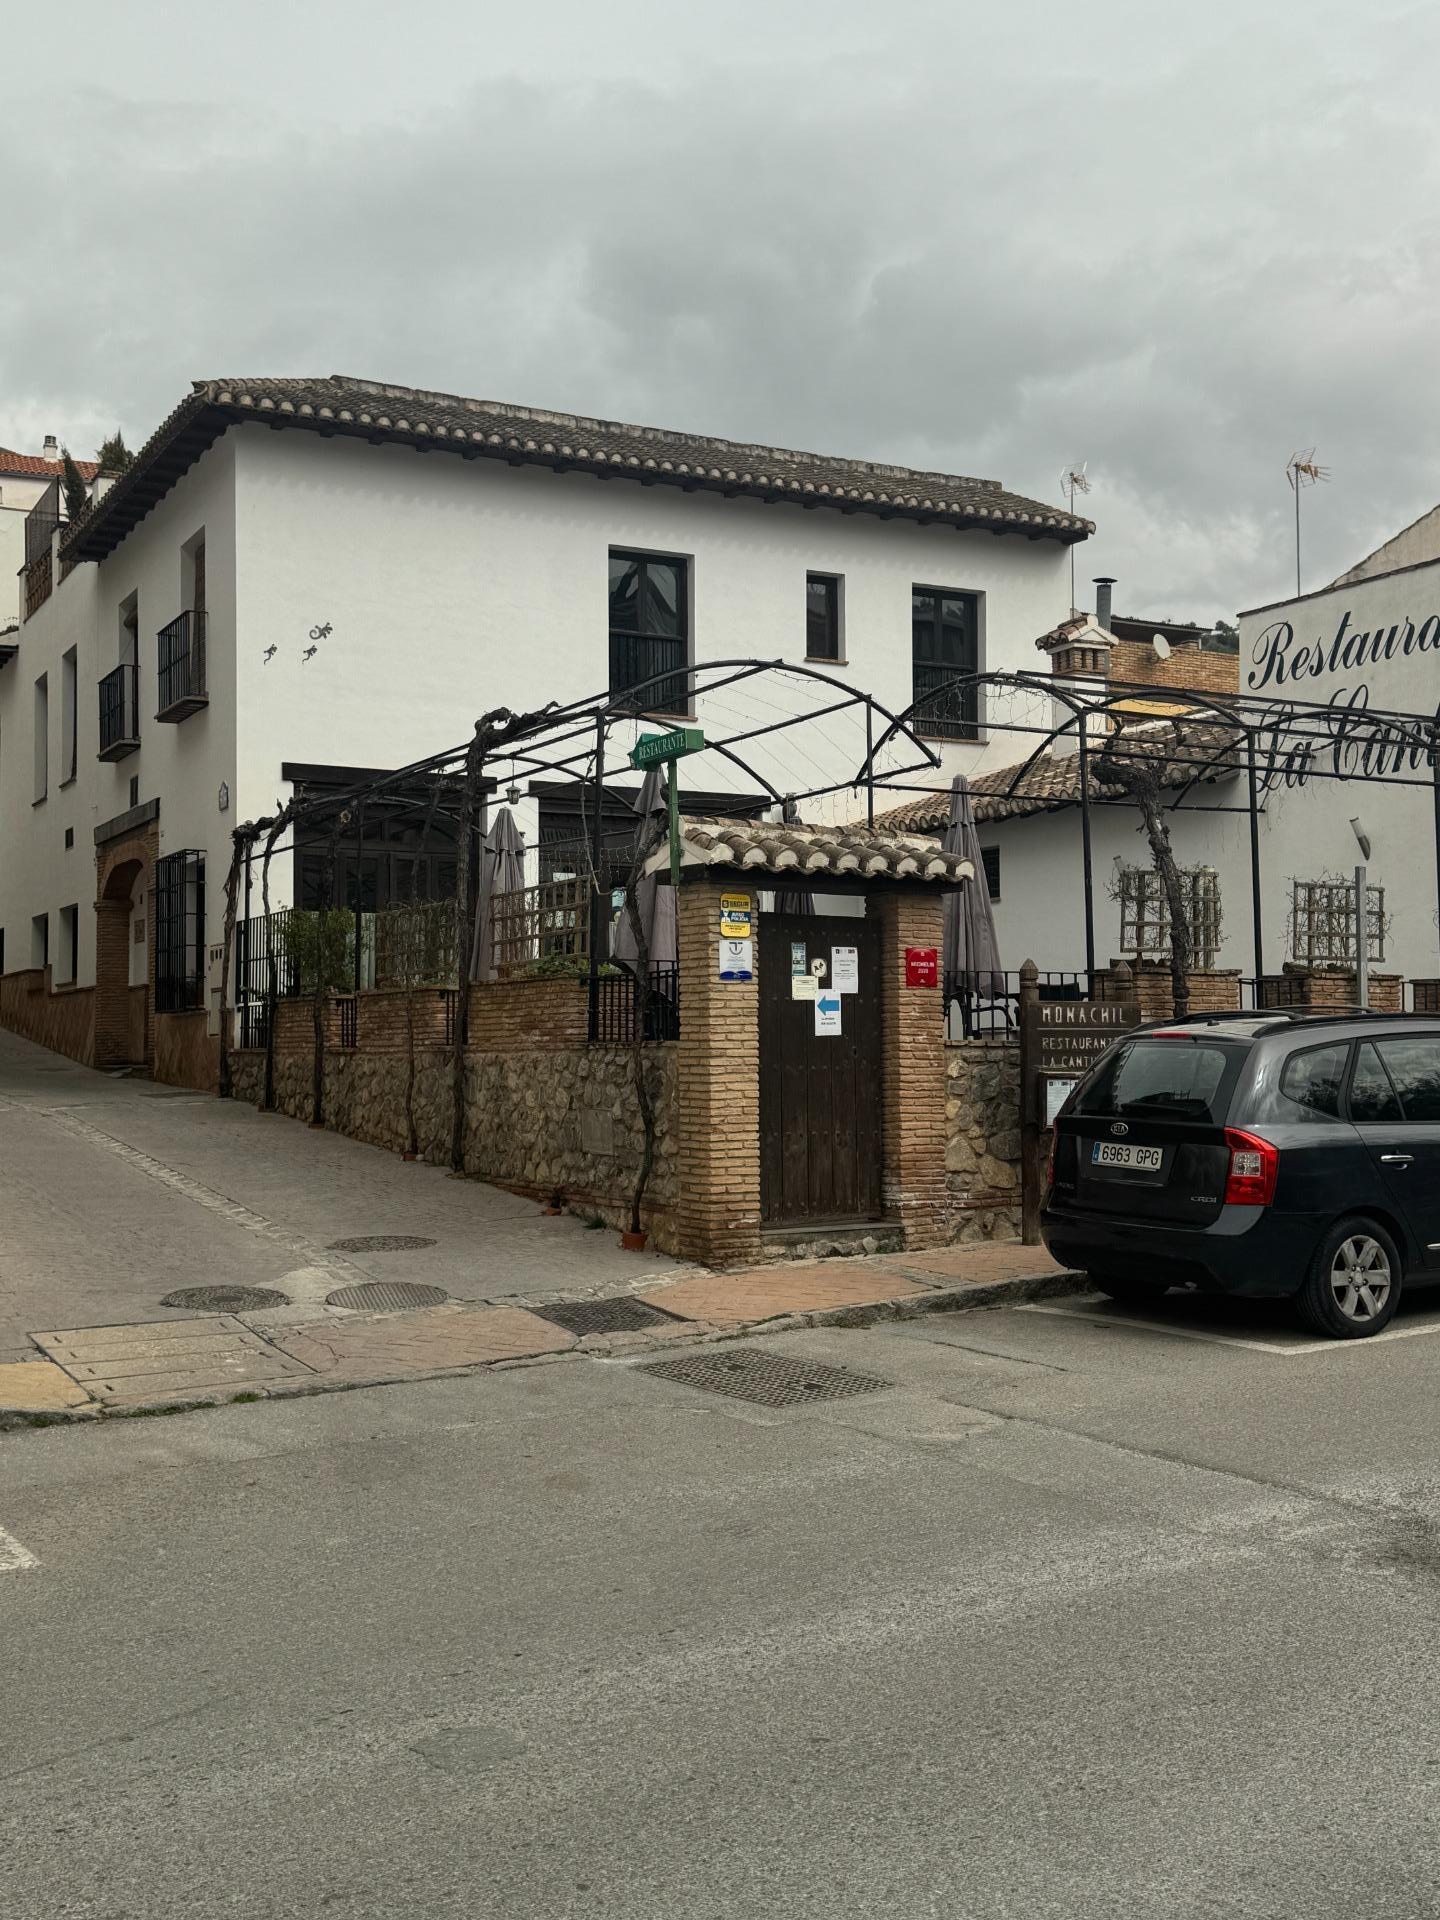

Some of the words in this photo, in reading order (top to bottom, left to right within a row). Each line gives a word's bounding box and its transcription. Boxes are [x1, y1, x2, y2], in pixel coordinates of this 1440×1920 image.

[638, 733, 686, 760] RESTAURANTE
[1256, 702, 1314, 794] La
[1042, 1006, 1128, 1024] MONACHIL
[1042, 1037, 1117, 1050] RESTAURANT
[1042, 1056, 1057, 1067] LA
[1102, 1145, 1131, 1163] 6963
[1136, 1149, 1159, 1166] GPG
